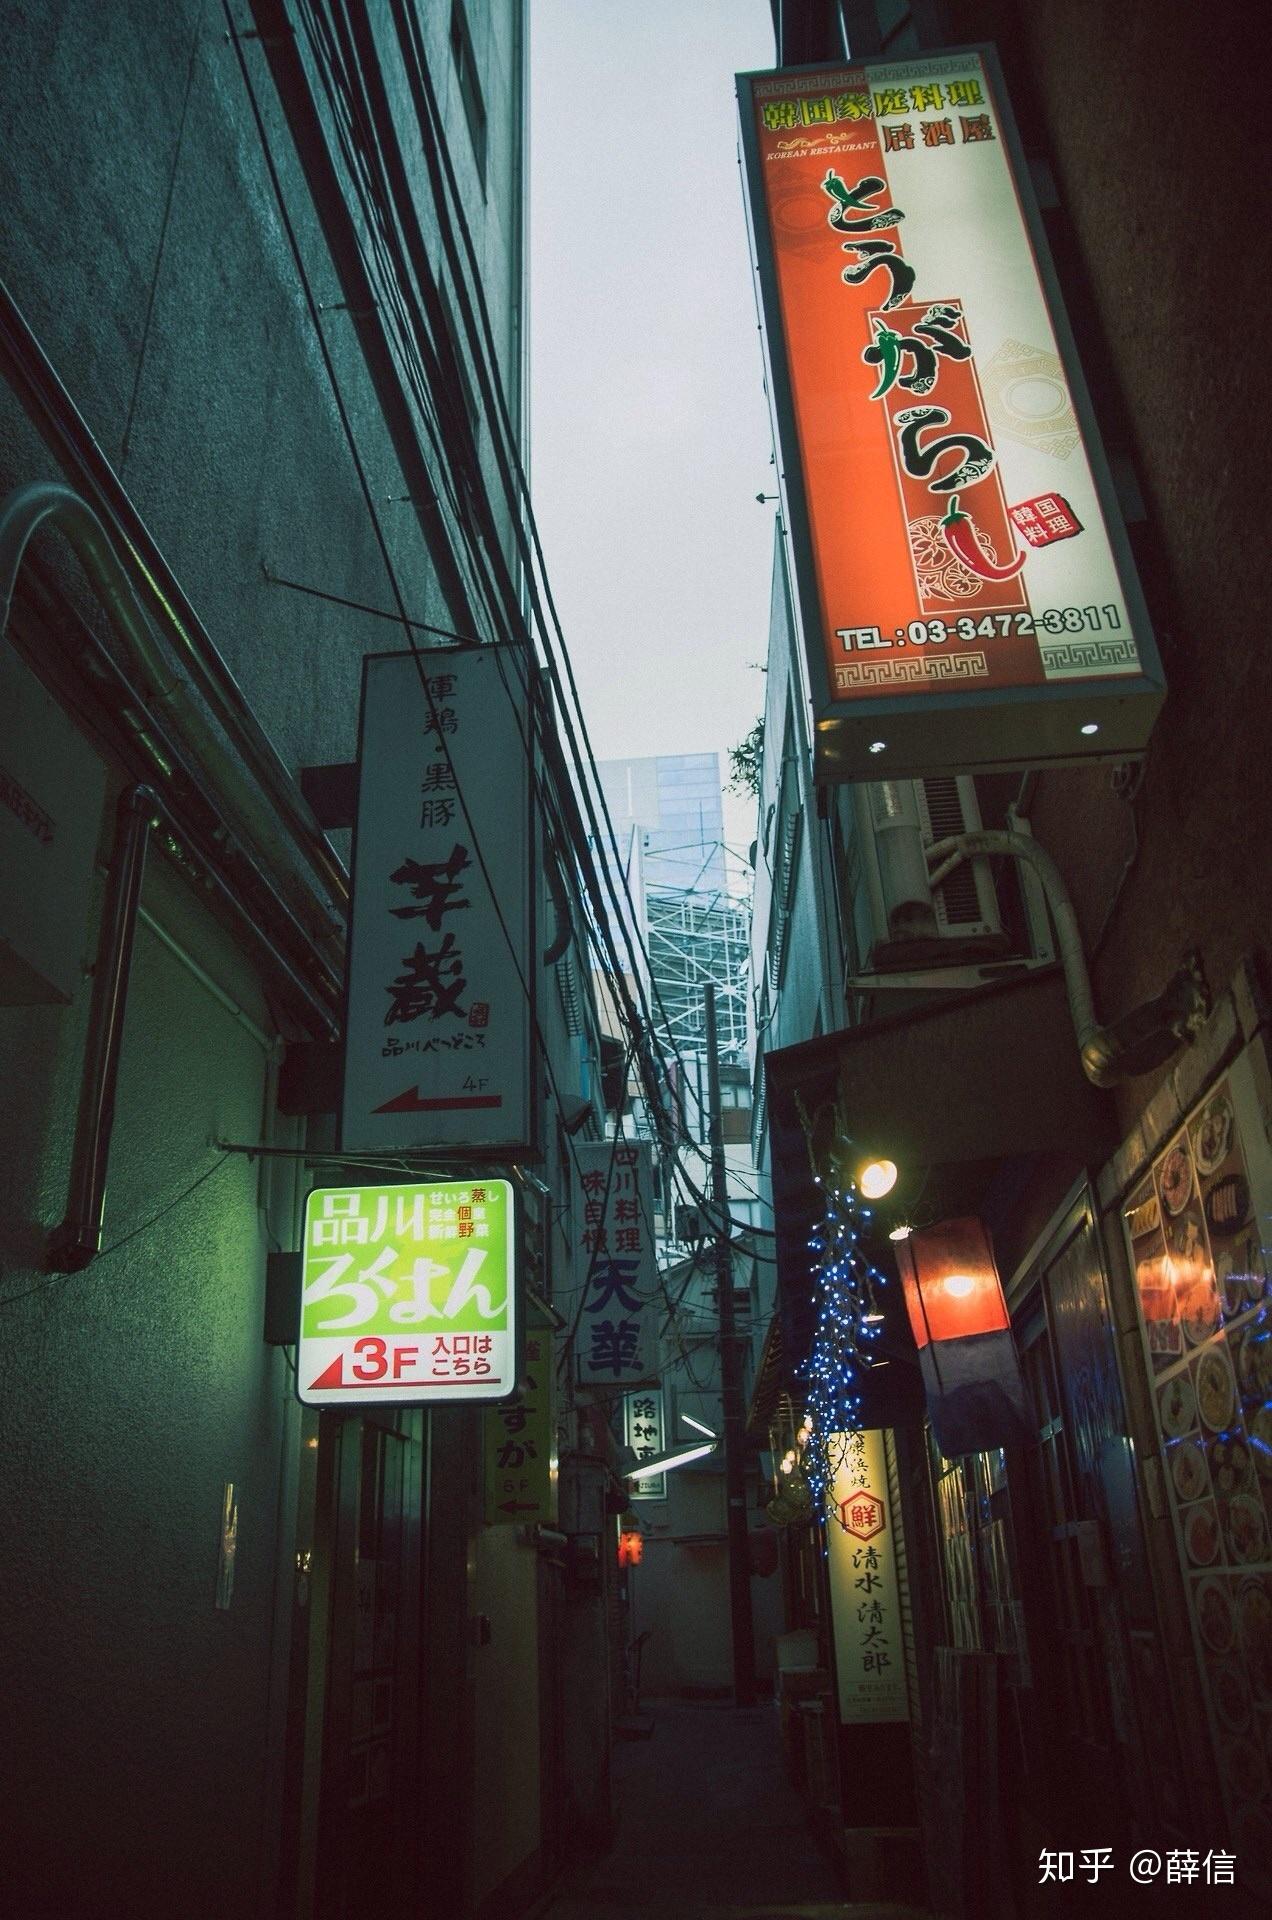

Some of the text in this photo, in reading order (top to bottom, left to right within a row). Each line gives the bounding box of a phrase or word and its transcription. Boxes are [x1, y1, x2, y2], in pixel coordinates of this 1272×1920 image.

[762, 79, 986, 131] 韓国家庭料理
[766, 141, 878, 161] KOREAN RESTAURANT
[883, 112, 997, 153] 居酒屋
[463, 1075, 490, 1092] 4F
[312, 1192, 424, 1246] 品川
[613, 1148, 643, 1253] 四川料理
[304, 1245, 508, 1330] ろくよん
[584, 1260, 643, 1377] 天華
[352, 1337, 419, 1381] 3F
[432, 1335, 492, 1355] 入口は
[432, 1357, 492, 1377] こちら
[850, 1504, 877, 1528] 鮮
